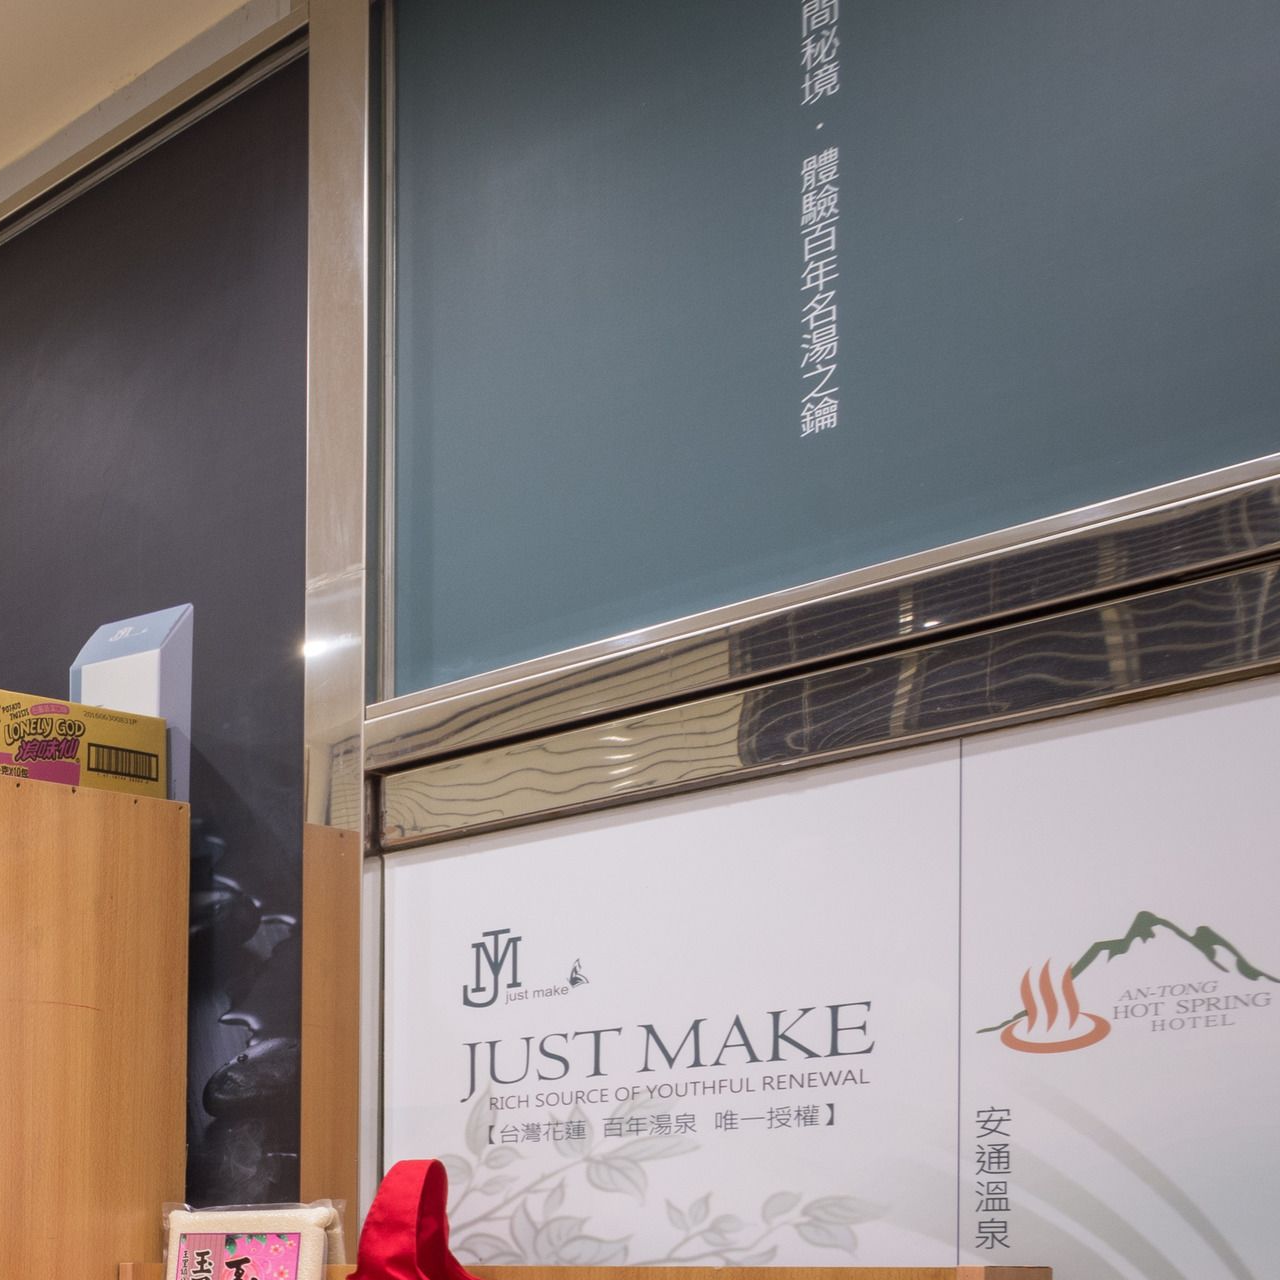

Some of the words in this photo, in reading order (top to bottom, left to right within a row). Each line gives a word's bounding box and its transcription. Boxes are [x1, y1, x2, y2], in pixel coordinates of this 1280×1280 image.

[4, 718, 53, 745] LONELY
[55, 720, 86, 738] GOD
[14, 737, 80, 762] 浪味仙
[505, 988, 529, 1005] just
[532, 983, 569, 999] make
[1118, 980, 1219, 1002] AN-TONG
[1112, 1002, 1165, 1020] HOT
[1176, 991, 1273, 1016] SPRING
[1151, 1014, 1236, 1033] HOTEL
[460, 1026, 623, 1103] JUST
[636, 1001, 876, 1074] MAKE
[489, 1094, 530, 1111] RICH
[535, 1087, 610, 1108] SOURCE
[614, 1085, 641, 1102] OF
[645, 1076, 756, 1100] YOUTHFUL
[762, 1068, 871, 1092] RENEWAL
[602, 1112, 697, 1140] 百年湯泉
[975, 1106, 1011, 1250] 安通溫泉
